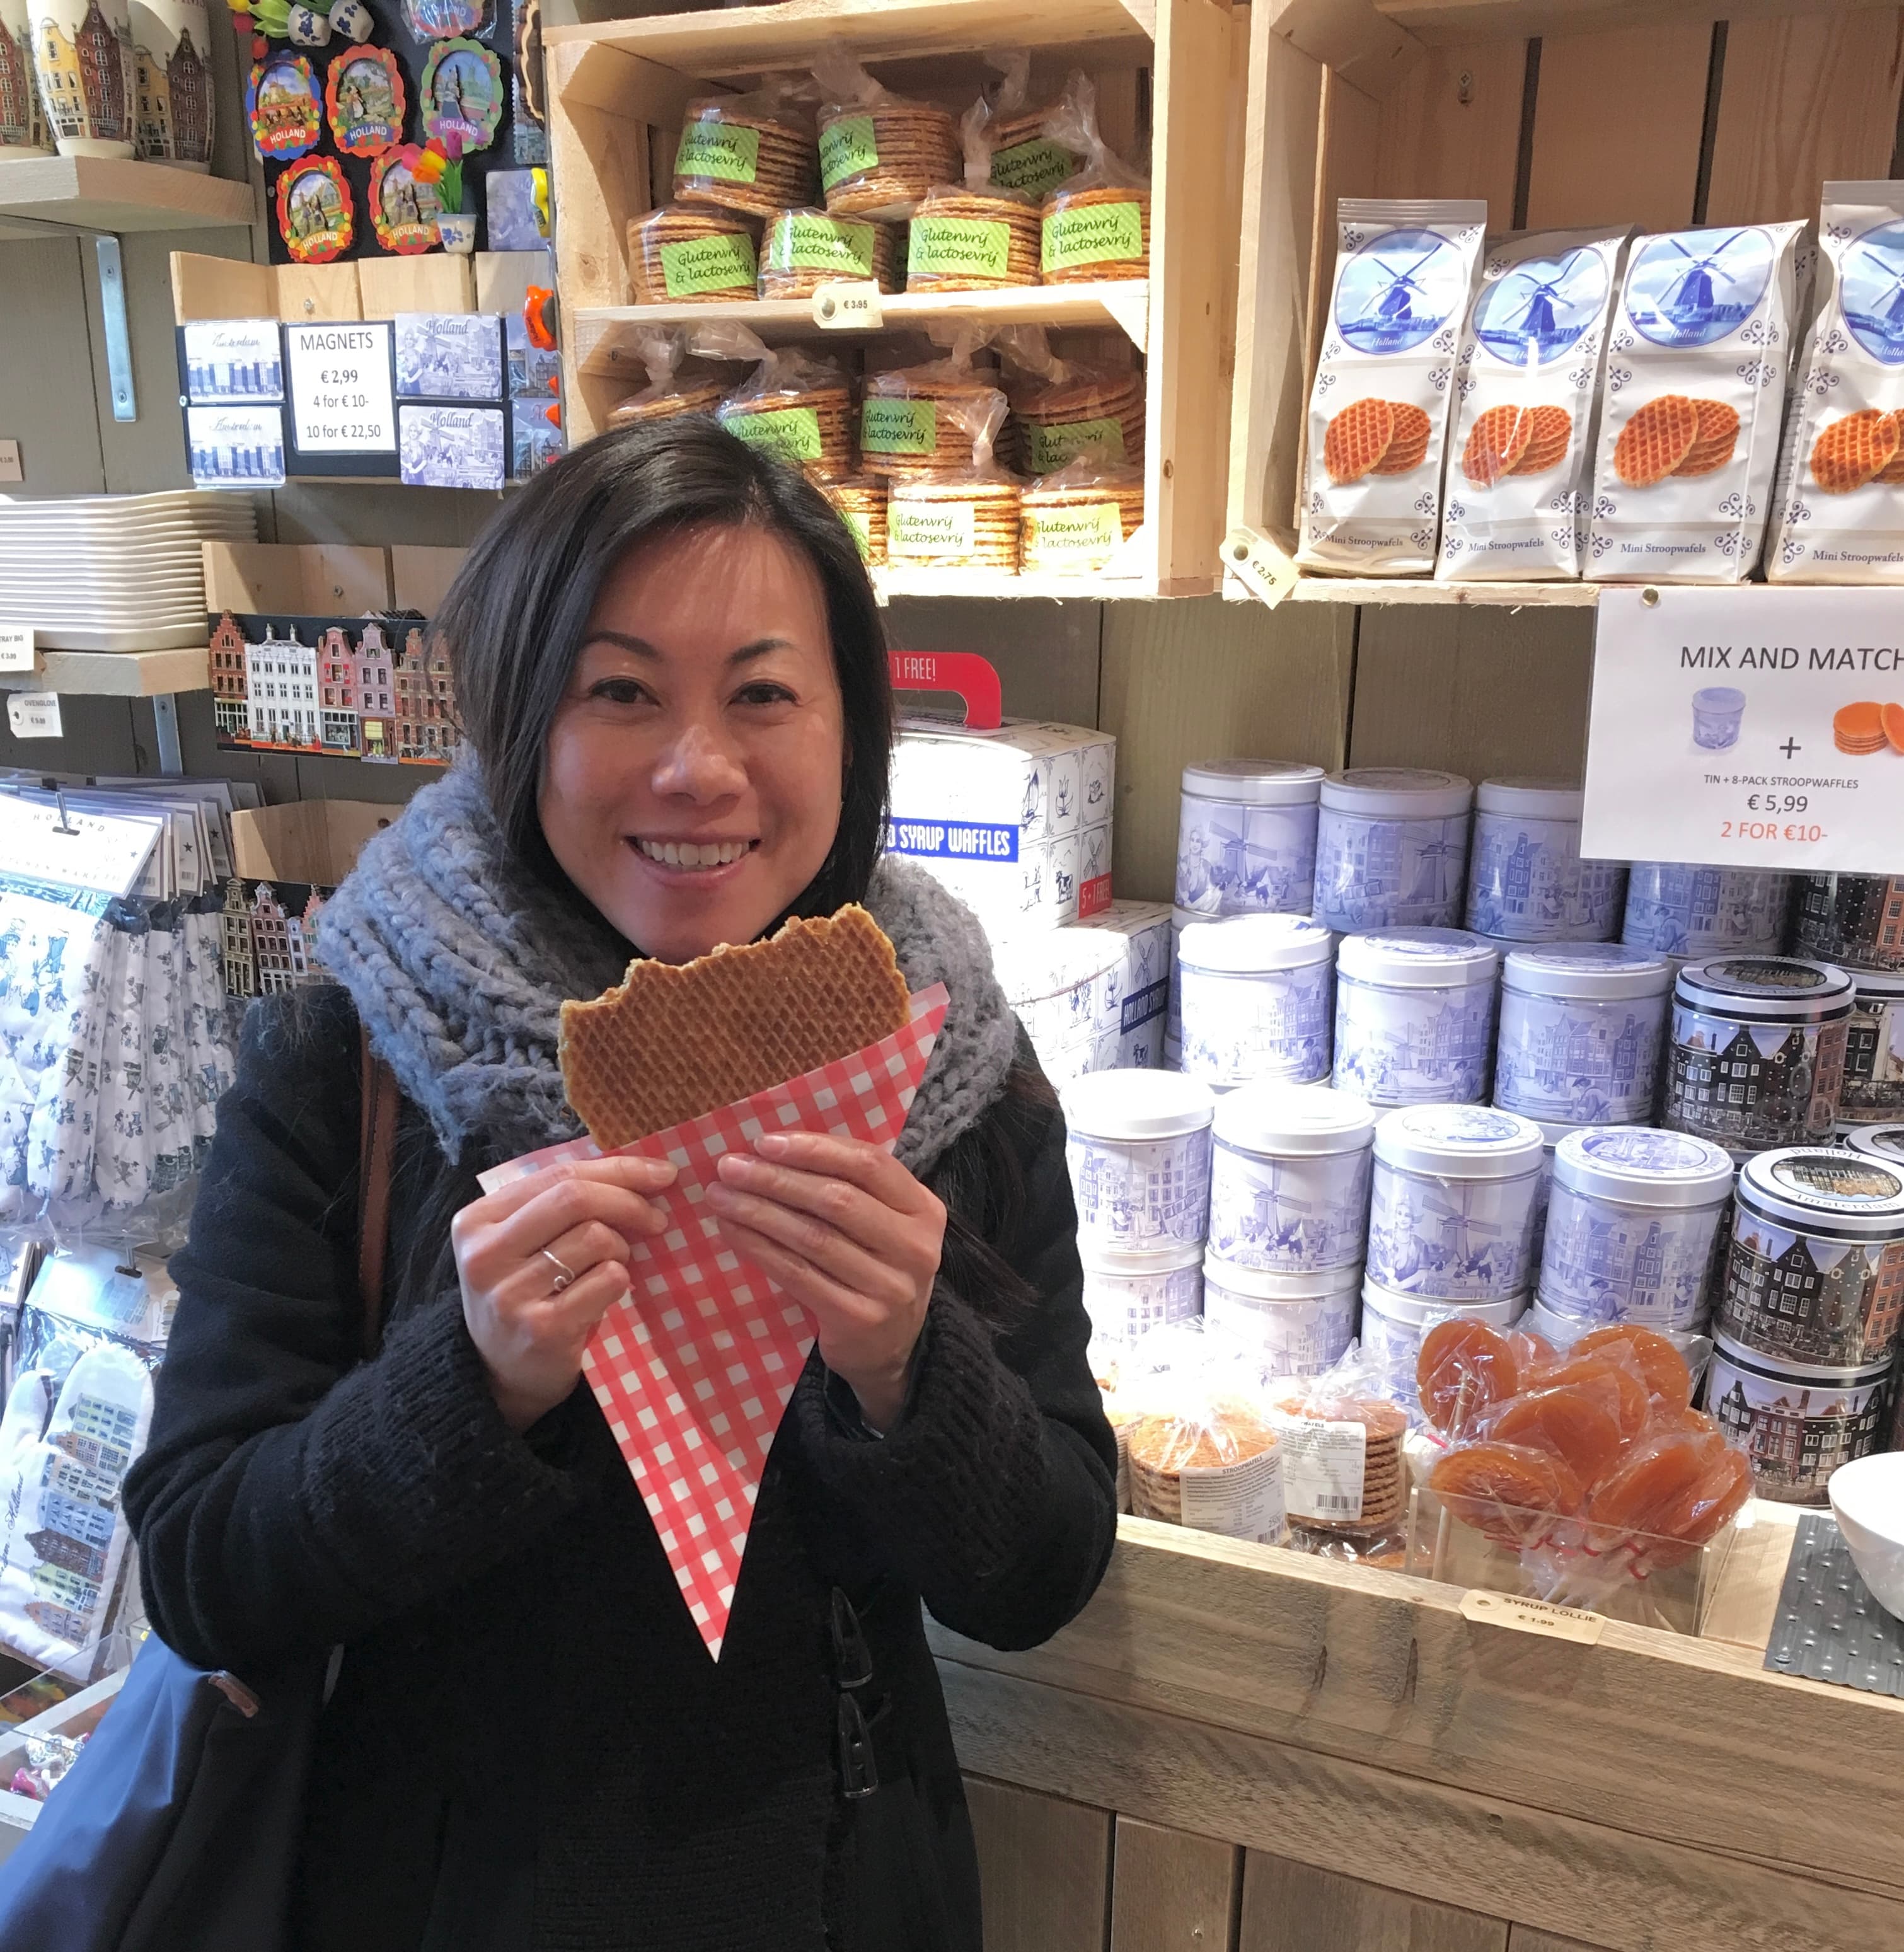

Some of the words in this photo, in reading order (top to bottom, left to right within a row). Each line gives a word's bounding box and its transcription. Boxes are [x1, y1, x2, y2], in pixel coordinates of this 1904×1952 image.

[269, 128, 307, 146] HOLLAND
[349, 125, 388, 141] HOLLAND
[439, 120, 479, 137] HOLLAND
[686, 148, 747, 172] lactosevrij
[990, 150, 1053, 179] Glutenvrij
[391, 225, 430, 242] HOLLAND
[1052, 214, 1121, 239] Glutenvrij
[303, 232, 338, 250] HOLLAND
[921, 228, 991, 248] Glutenvrij
[1048, 244, 1056, 258] &
[1059, 231, 1133, 255] lactosevrij
[678, 245, 741, 267] Glutenvrij
[792, 241, 865, 265] lactosevrij
[916, 246, 925, 260] &
[926, 246, 1000, 267] lactosevrij
[675, 271, 686, 284] &
[689, 258, 751, 280] lactosevrij
[843, 300, 849, 309] €
[424, 318, 470, 336] Holland
[1668, 328, 1707, 338] Holland
[300, 332, 373, 350] MAGNETS
[1371, 337, 1404, 348] Holland
[321, 370, 329, 383] €
[332, 369, 358, 385] 2,99
[313, 395, 320, 408] 4
[323, 395, 338, 408] for
[342, 395, 349, 407] €
[352, 394, 369, 407] 10-
[427, 410, 473, 429] Holland
[737, 419, 798, 438] lutenvrij
[306, 425, 320, 438] 10
[322, 424, 338, 438] for
[341, 425, 348, 437] €
[350, 424, 381, 440] 22,50
[868, 425, 927, 444] lactosevrij
[896, 513, 954, 531] Glutenvrij
[900, 530, 965, 547] lactosevrij
[1042, 530, 1113, 548] lactosevrij
[1325, 534, 1346, 546] Mini
[1347, 536, 1404, 548] Stroopwafels
[1468, 541, 1487, 552] Mini
[1488, 538, 1545, 552] Stroopwafels
[1620, 543, 1643, 553] Mini
[1644, 543, 1707, 555] Stroopwafels
[1812, 550, 1839, 562] Mini
[1840, 552, 1904, 564] Stroopwafels
[1252, 560, 1260, 569] €
[1680, 646, 1732, 668] MIX
[1738, 647, 1799, 669] AND
[1808, 647, 1904, 671] MATCH
[894, 657, 901, 679] 1
[904, 657, 936, 681] FREE!
[1704, 775, 1722, 784] TIN
[1731, 775, 1768, 786] 8-PACK
[1770, 777, 1859, 789] STROOPWAFFLES
[1747, 794, 1759, 811] €
[1765, 795, 1809, 814] 5,99
[1721, 821, 1732, 838] 2
[1738, 822, 1777, 840] FOR
[1783, 823, 1828, 842] €10-
[900, 825, 944, 852] SYRUP
[947, 828, 1011, 857] WAFFLES
[1082, 887, 1087, 910] 5
[1124, 993, 1148, 1028] HOLLAND
[1789, 1148, 1862, 1160] Holland
[1790, 1194, 1901, 1211] Amsterdam
[1221, 1455, 1263, 1475] STROOPWAFELS
[1503, 1597, 1549, 1612] SYRUP
[1551, 1607, 1598, 1624] LOLLIE
